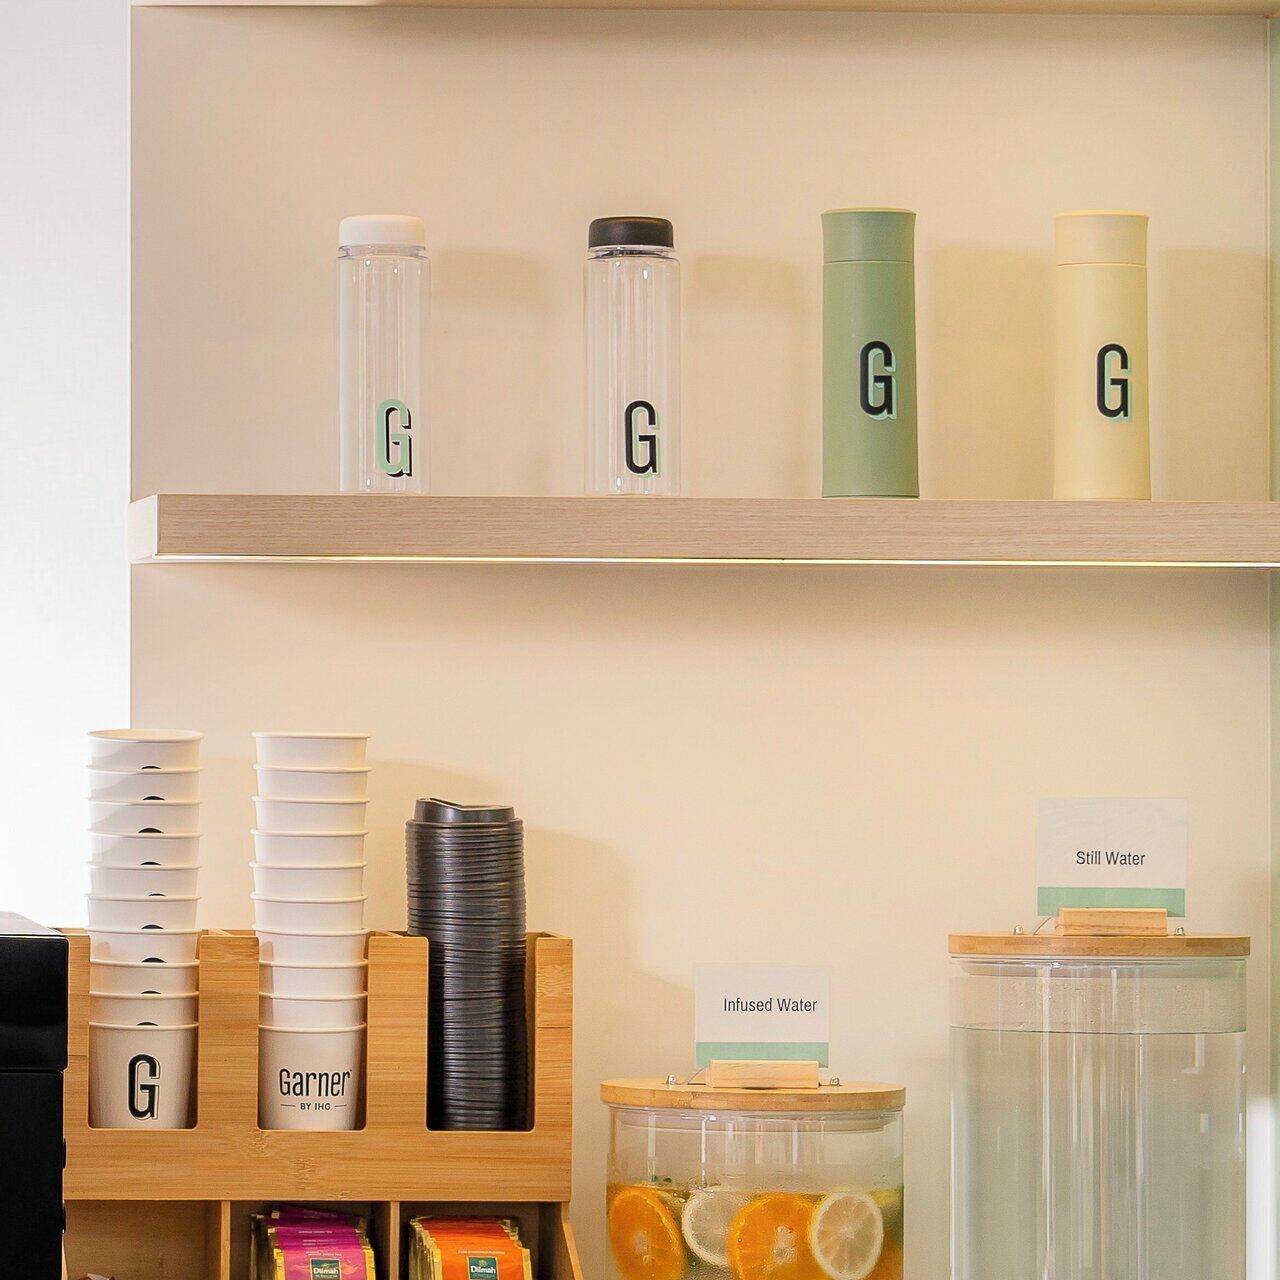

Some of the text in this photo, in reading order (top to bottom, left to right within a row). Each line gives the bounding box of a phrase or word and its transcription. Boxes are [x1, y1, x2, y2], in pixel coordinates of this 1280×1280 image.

[859, 340, 896, 420] G
[1096, 342, 1132, 422] G
[375, 398, 412, 477] G
[625, 400, 660, 476] G
[1076, 850, 1145, 866] Still Water
[723, 997, 817, 1013] Infused Water
[127, 1053, 161, 1121] G
[279, 1068, 351, 1097] Garner
[300, 1102, 331, 1111] BY IHG
[470, 1266, 496, 1274] Dilmah
